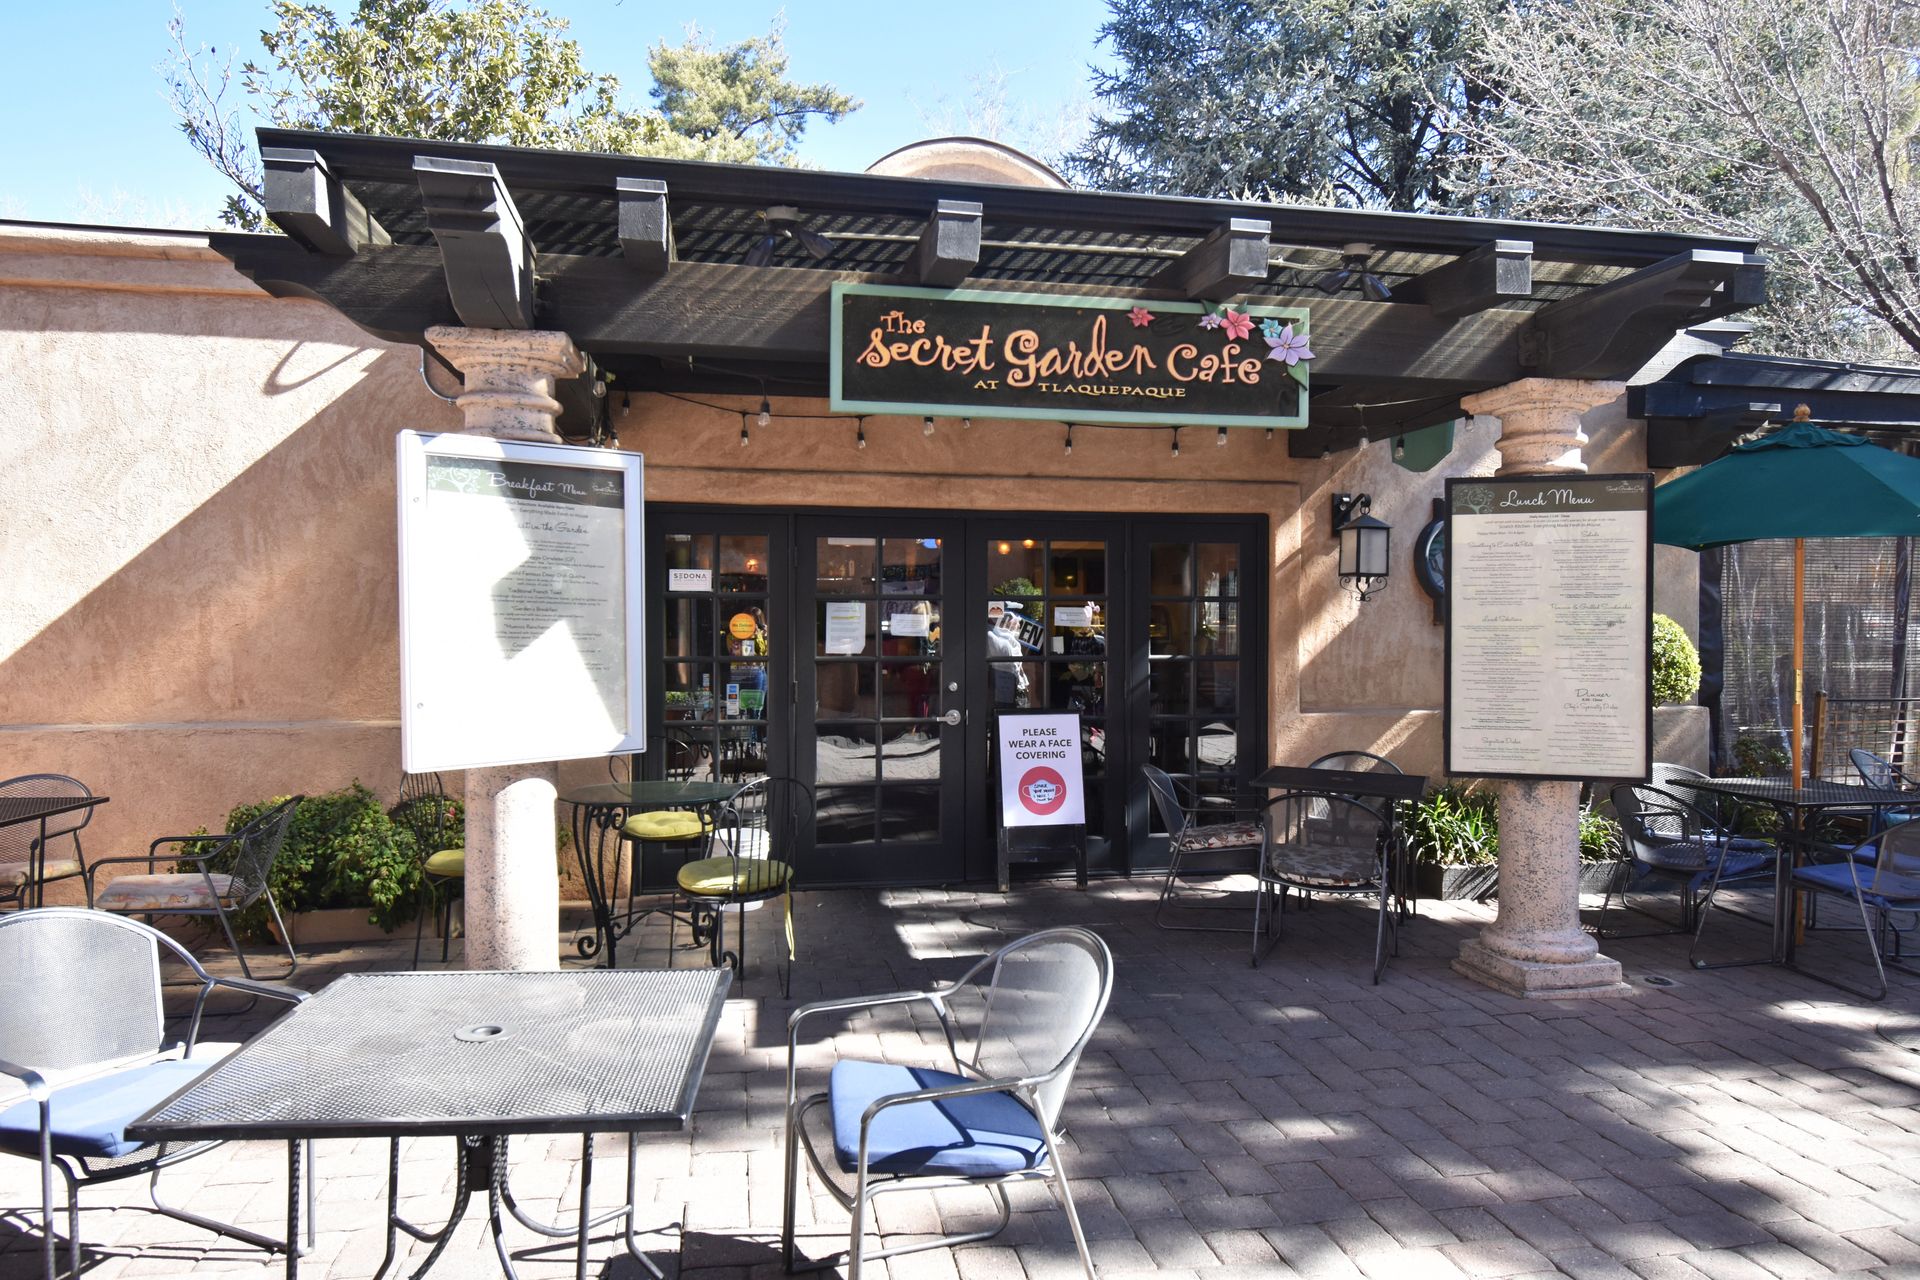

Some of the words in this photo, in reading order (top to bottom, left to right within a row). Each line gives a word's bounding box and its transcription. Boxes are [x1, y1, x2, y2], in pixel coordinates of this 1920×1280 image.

[880, 310, 925, 335] The
[856, 325, 995, 376] Secret
[1004, 314, 1157, 388] Garden
[1166, 343, 1262, 384] Cafe
[974, 379, 998, 390] AT
[1038, 383, 1186, 398] TLAQUEPAQUE
[486, 472, 556, 499] Breakfast
[557, 483, 588, 496] Menu
[1500, 489, 1548, 507] Lunch
[1547, 489, 1595, 505] Menu
[555, 522, 589, 534] Garden
[1575, 688, 1612, 698] Dinner
[1022, 728, 1057, 736] PLEASE
[1008, 740, 1037, 748] WEAR
[1048, 739, 1072, 747] FACE
[1015, 751, 1066, 759] COVERING
